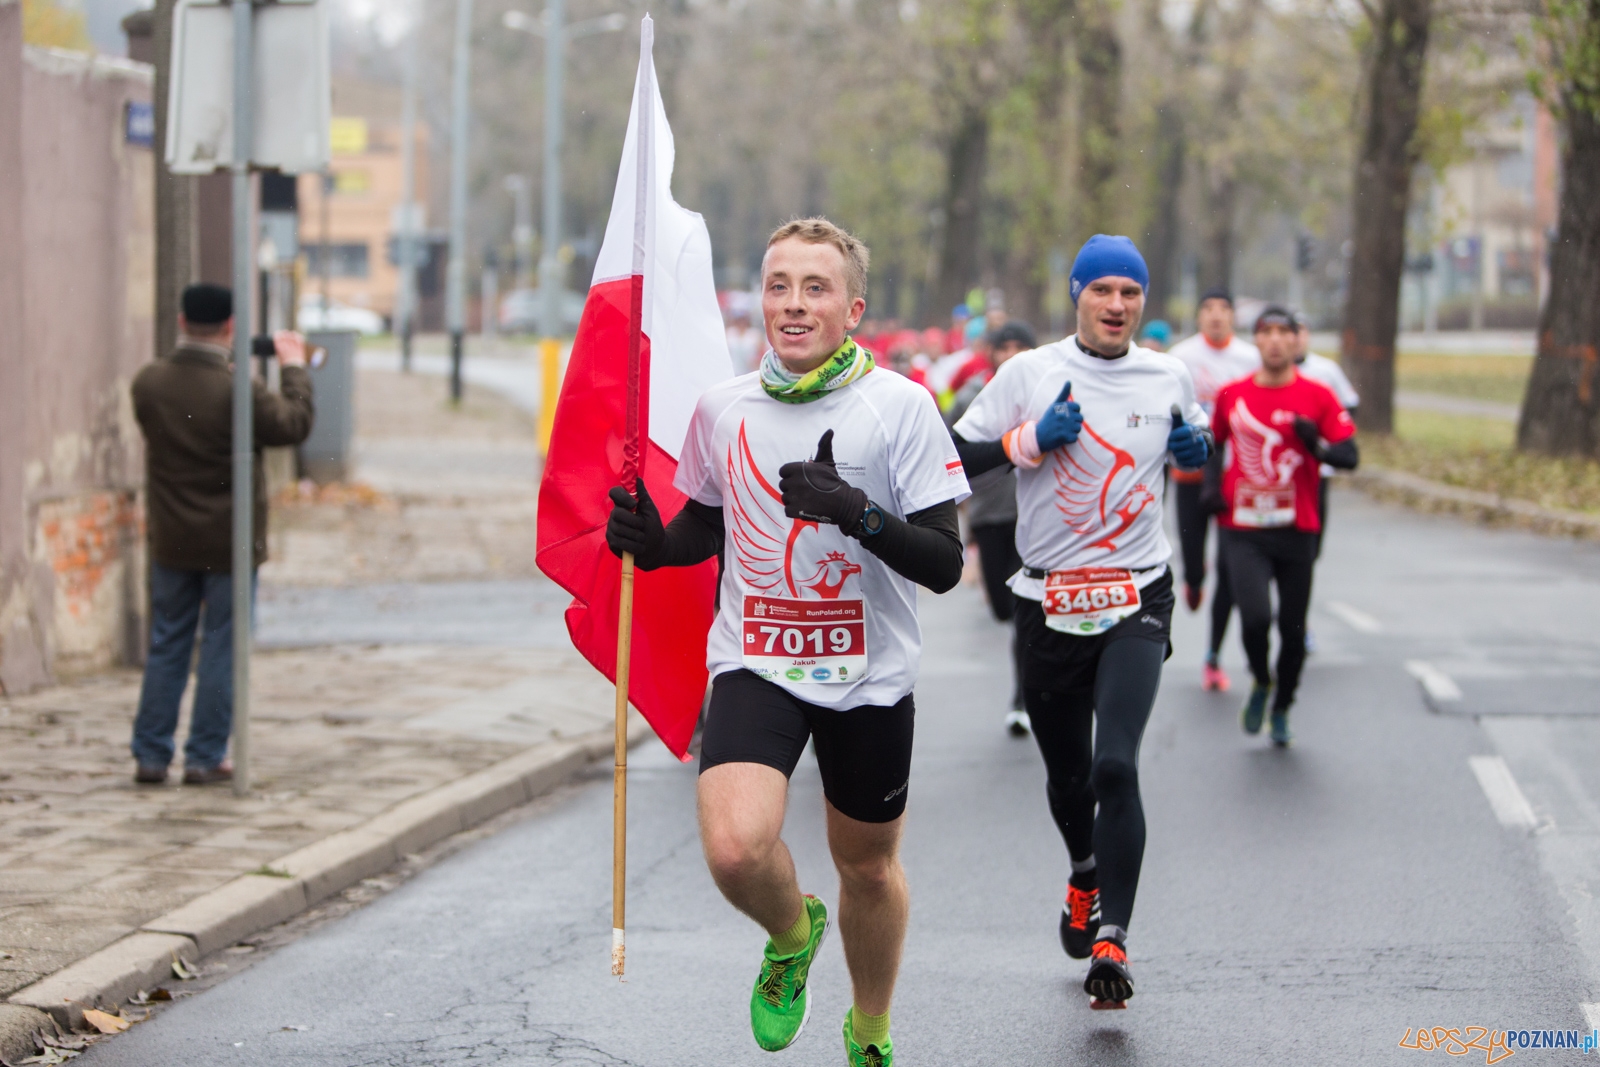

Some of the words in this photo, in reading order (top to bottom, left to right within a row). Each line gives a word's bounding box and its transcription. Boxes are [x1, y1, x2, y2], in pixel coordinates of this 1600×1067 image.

[806, 609, 856, 617] RunPoland.org
[1054, 586, 1129, 614] 3468
[746, 633, 756, 644] B
[760, 625, 852, 655] 7019
